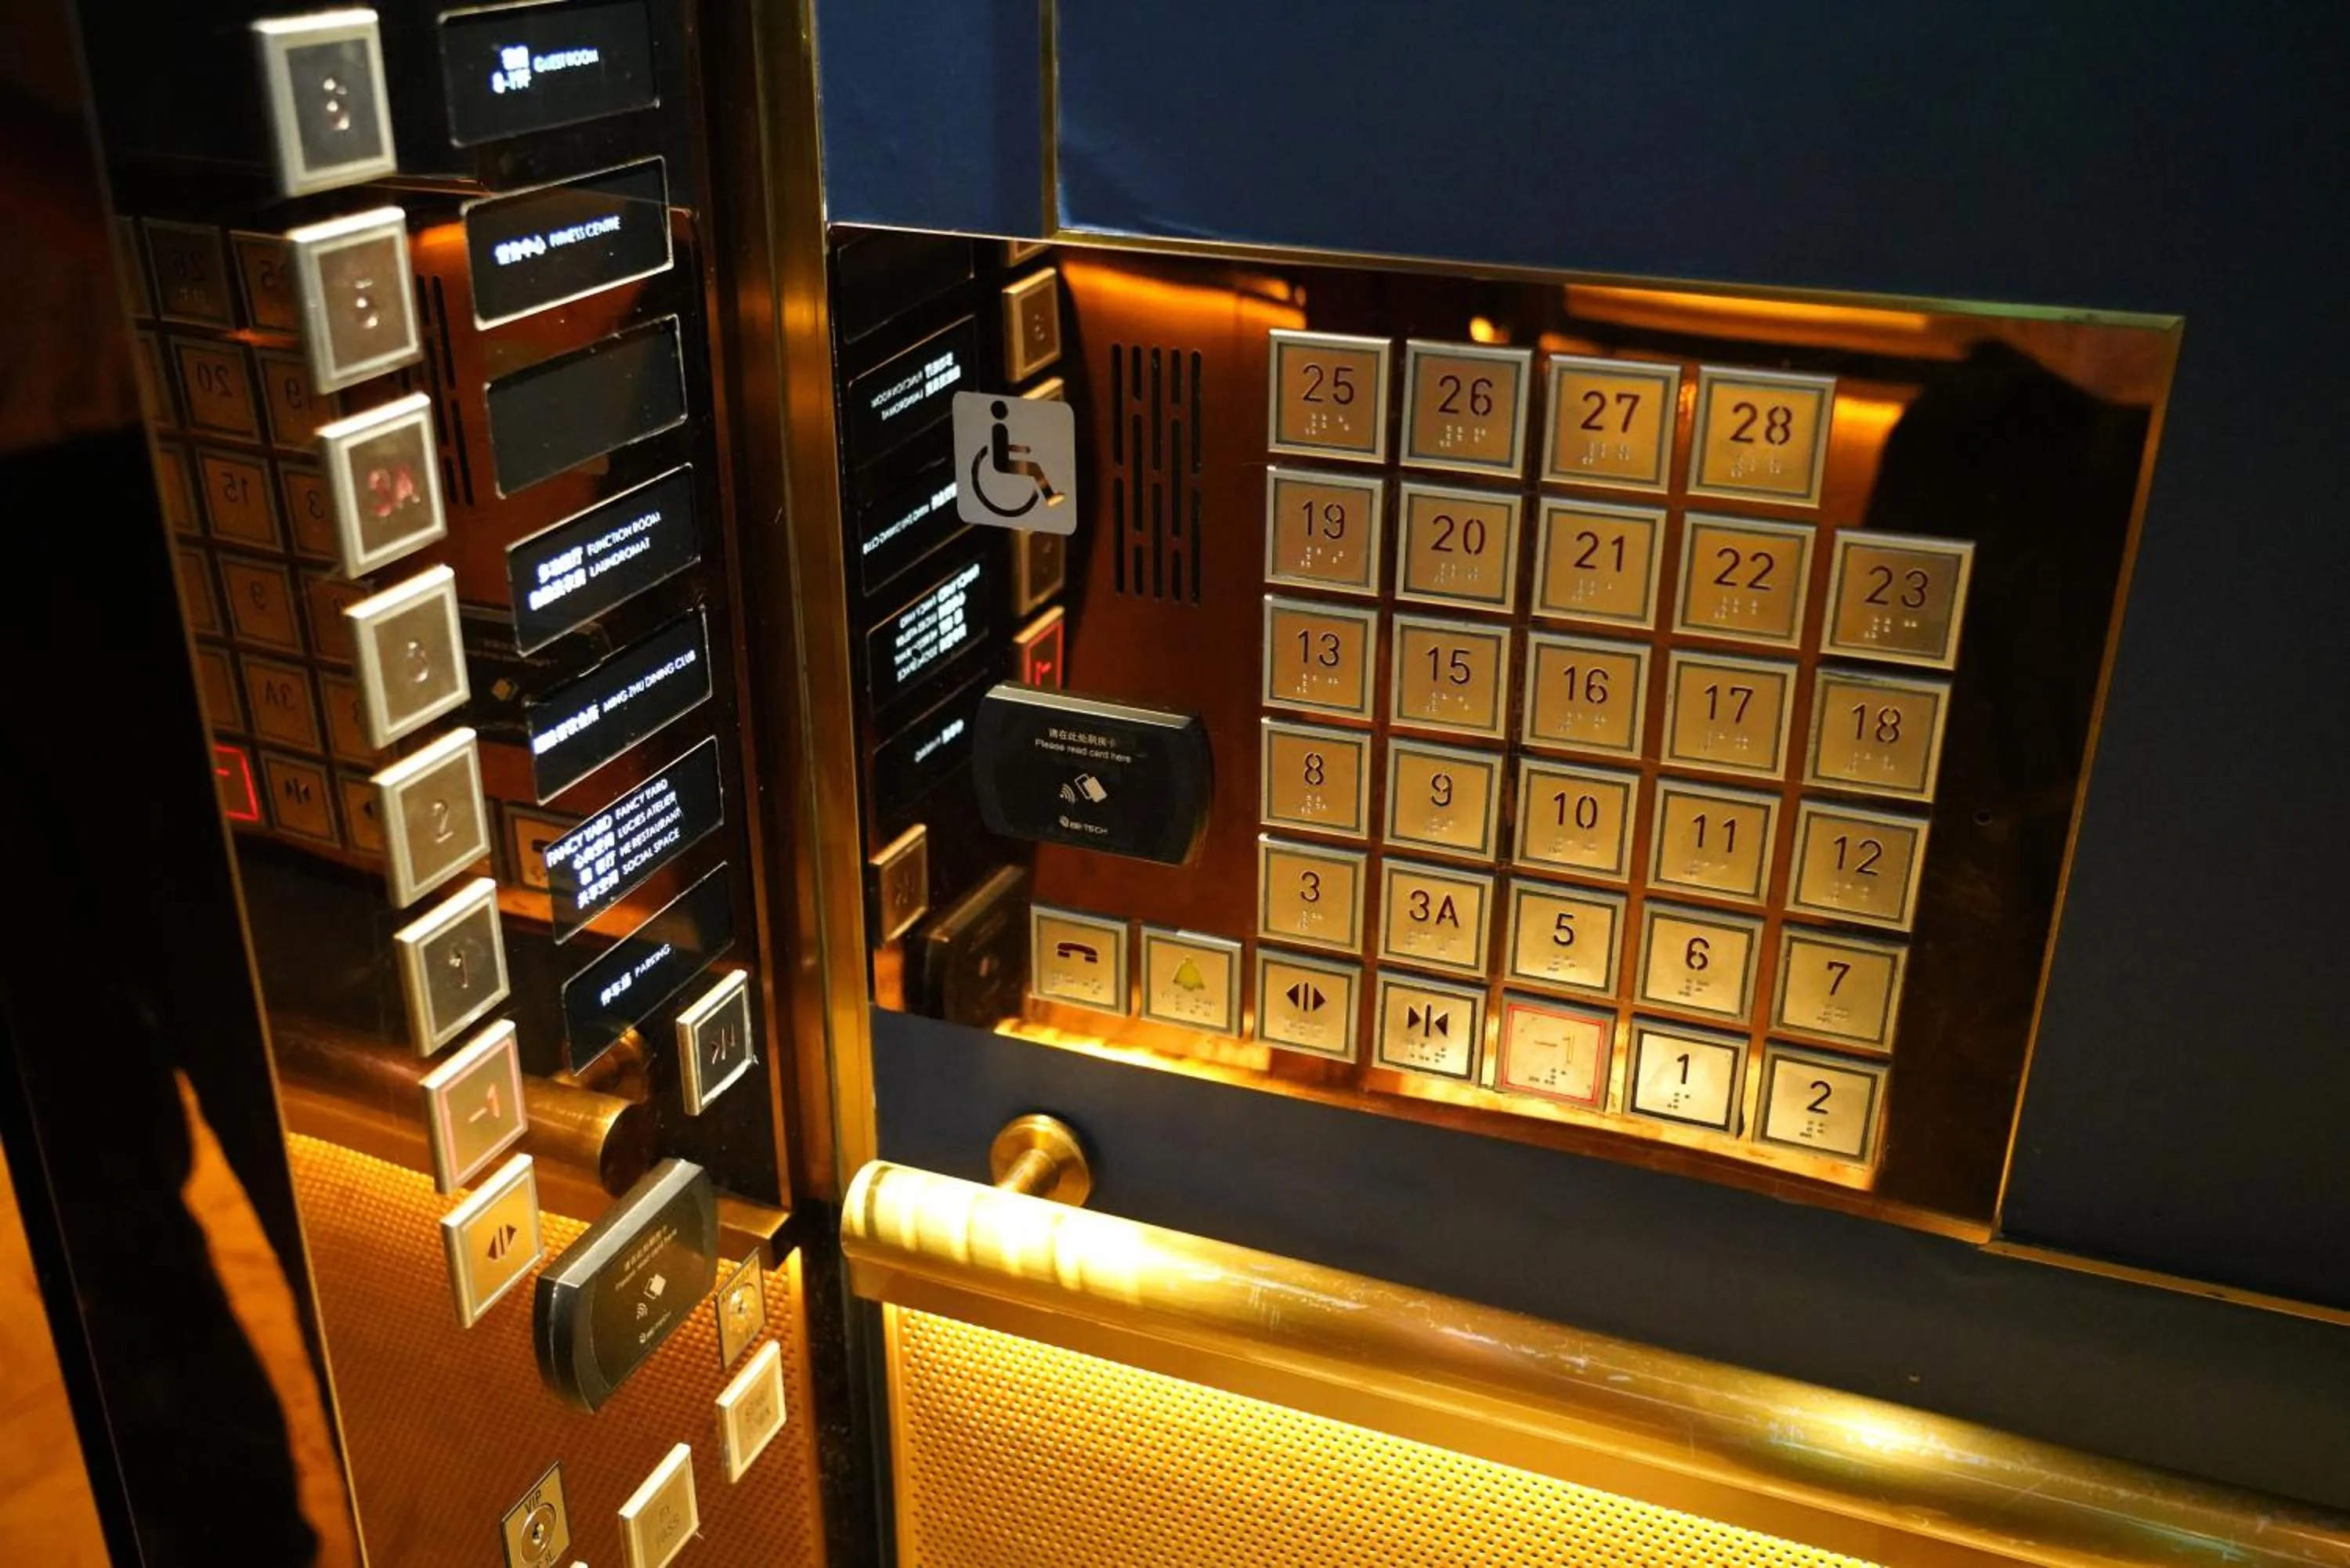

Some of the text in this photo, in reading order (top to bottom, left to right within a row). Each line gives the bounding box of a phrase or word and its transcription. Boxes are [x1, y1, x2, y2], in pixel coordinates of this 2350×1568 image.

[1303, 363, 1354, 405] 25
[1438, 375, 1493, 416] 26
[1580, 391, 1640, 433] 27
[1730, 402, 1792, 445] 28
[588, 511, 661, 555] FUNCTION ROOM
[1303, 500, 1346, 540] 19
[1431, 515, 1486, 555] 20
[589, 537, 651, 577] LAUNDROMAT
[1574, 532, 1625, 573] 21
[1713, 547, 1776, 591] 22
[1865, 565, 1929, 609] 23
[1298, 630, 1341, 667] 13
[1426, 647, 1471, 685] 15
[645, 660, 675, 688] DINING
[1564, 666, 1609, 704] 16
[1705, 685, 1754, 724] 17
[1853, 704, 1901, 744] 18
[1035, 739, 1133, 764] Please read card here
[1304, 753, 1325, 785] 8
[616, 779, 668, 819] FANCY YARD
[646, 790, 678, 818] ATELIER
[1431, 774, 1452, 807] 9
[430, 798, 454, 844] 2
[1553, 792, 1598, 829] 10
[622, 848, 656, 876] SOCIAL
[653, 827, 681, 854] SPACE
[1693, 814, 1737, 853] 11
[1834, 836, 1882, 876] 12
[1300, 871, 1321, 902] 3
[1409, 890, 1459, 928] 3A
[1553, 912, 1575, 947] 5
[634, 943, 671, 977] PARKING
[1685, 938, 1710, 971] 6
[1827, 961, 1851, 995] 7
[1677, 1053, 1690, 1086] 1
[468, 1082, 501, 1123] -1
[1806, 1080, 1832, 1115] 2
[525, 1489, 542, 1513] VIP
